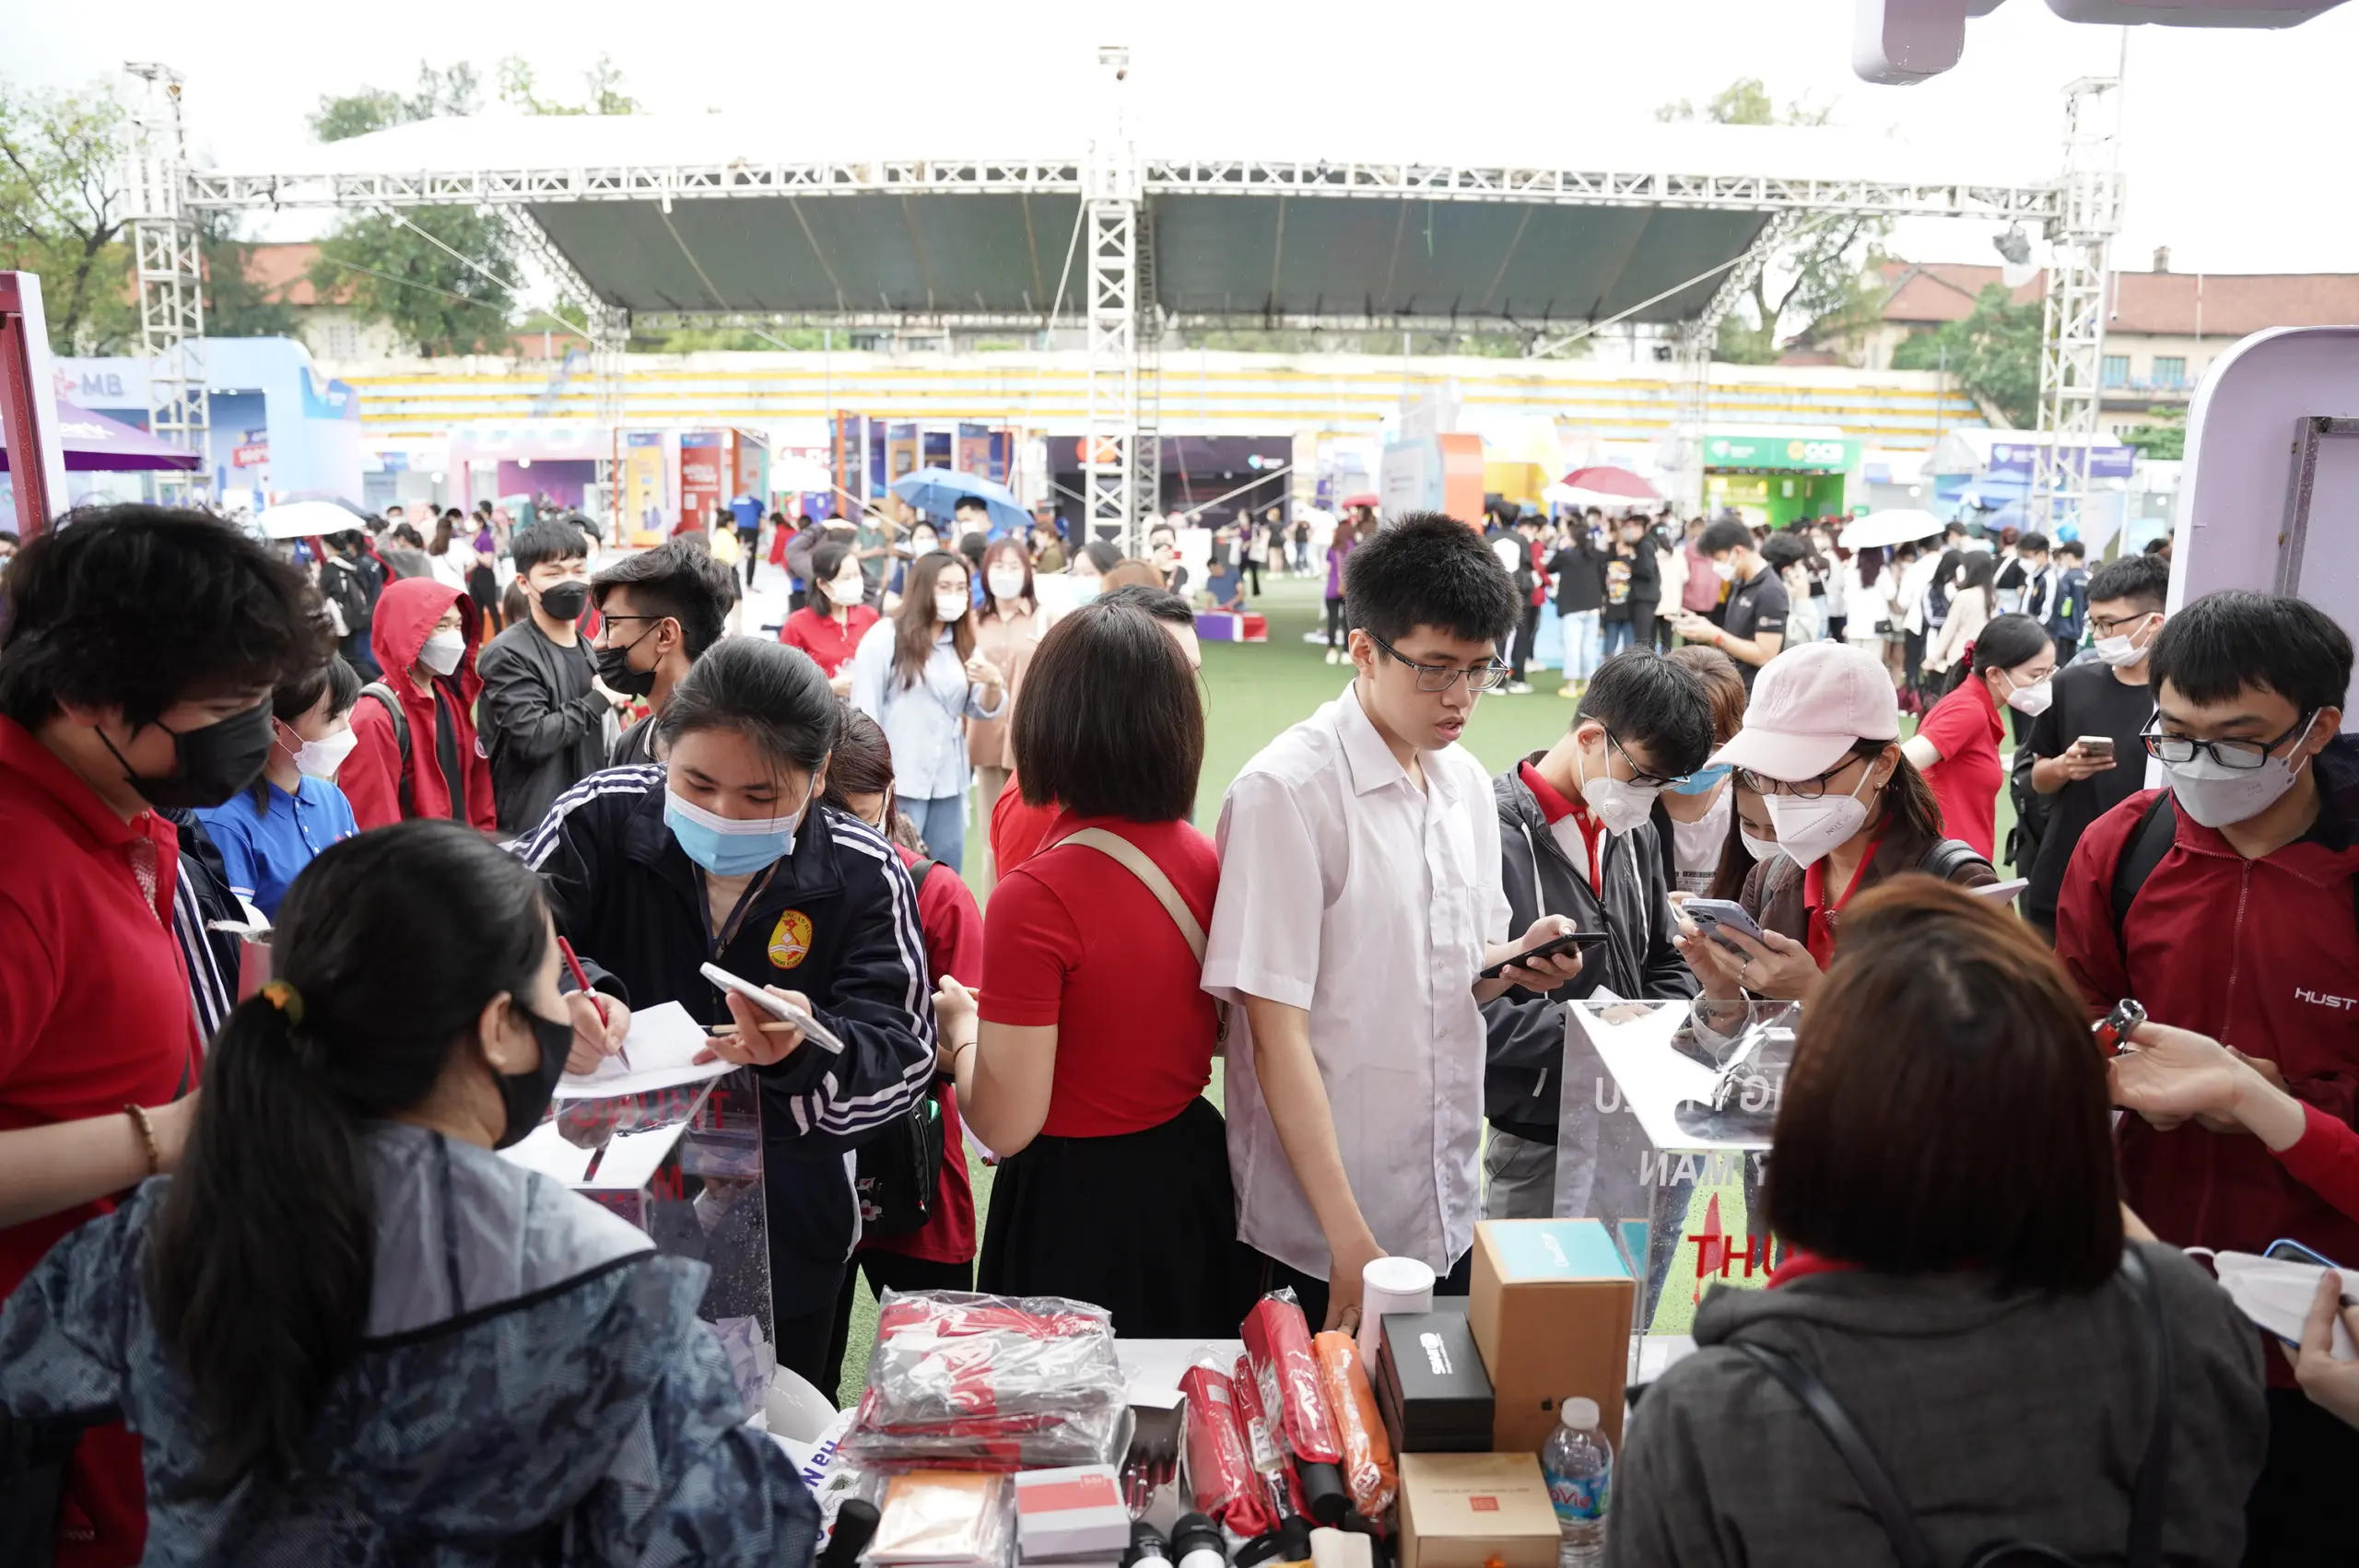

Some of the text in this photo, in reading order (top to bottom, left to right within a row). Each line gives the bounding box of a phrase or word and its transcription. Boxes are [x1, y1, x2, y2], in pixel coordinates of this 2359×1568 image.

[82, 373, 123, 396] MB
[2294, 987, 2358, 1011] HUST
[1687, 1235, 1794, 1279] THU
[1550, 1487, 1593, 1510] aVie
